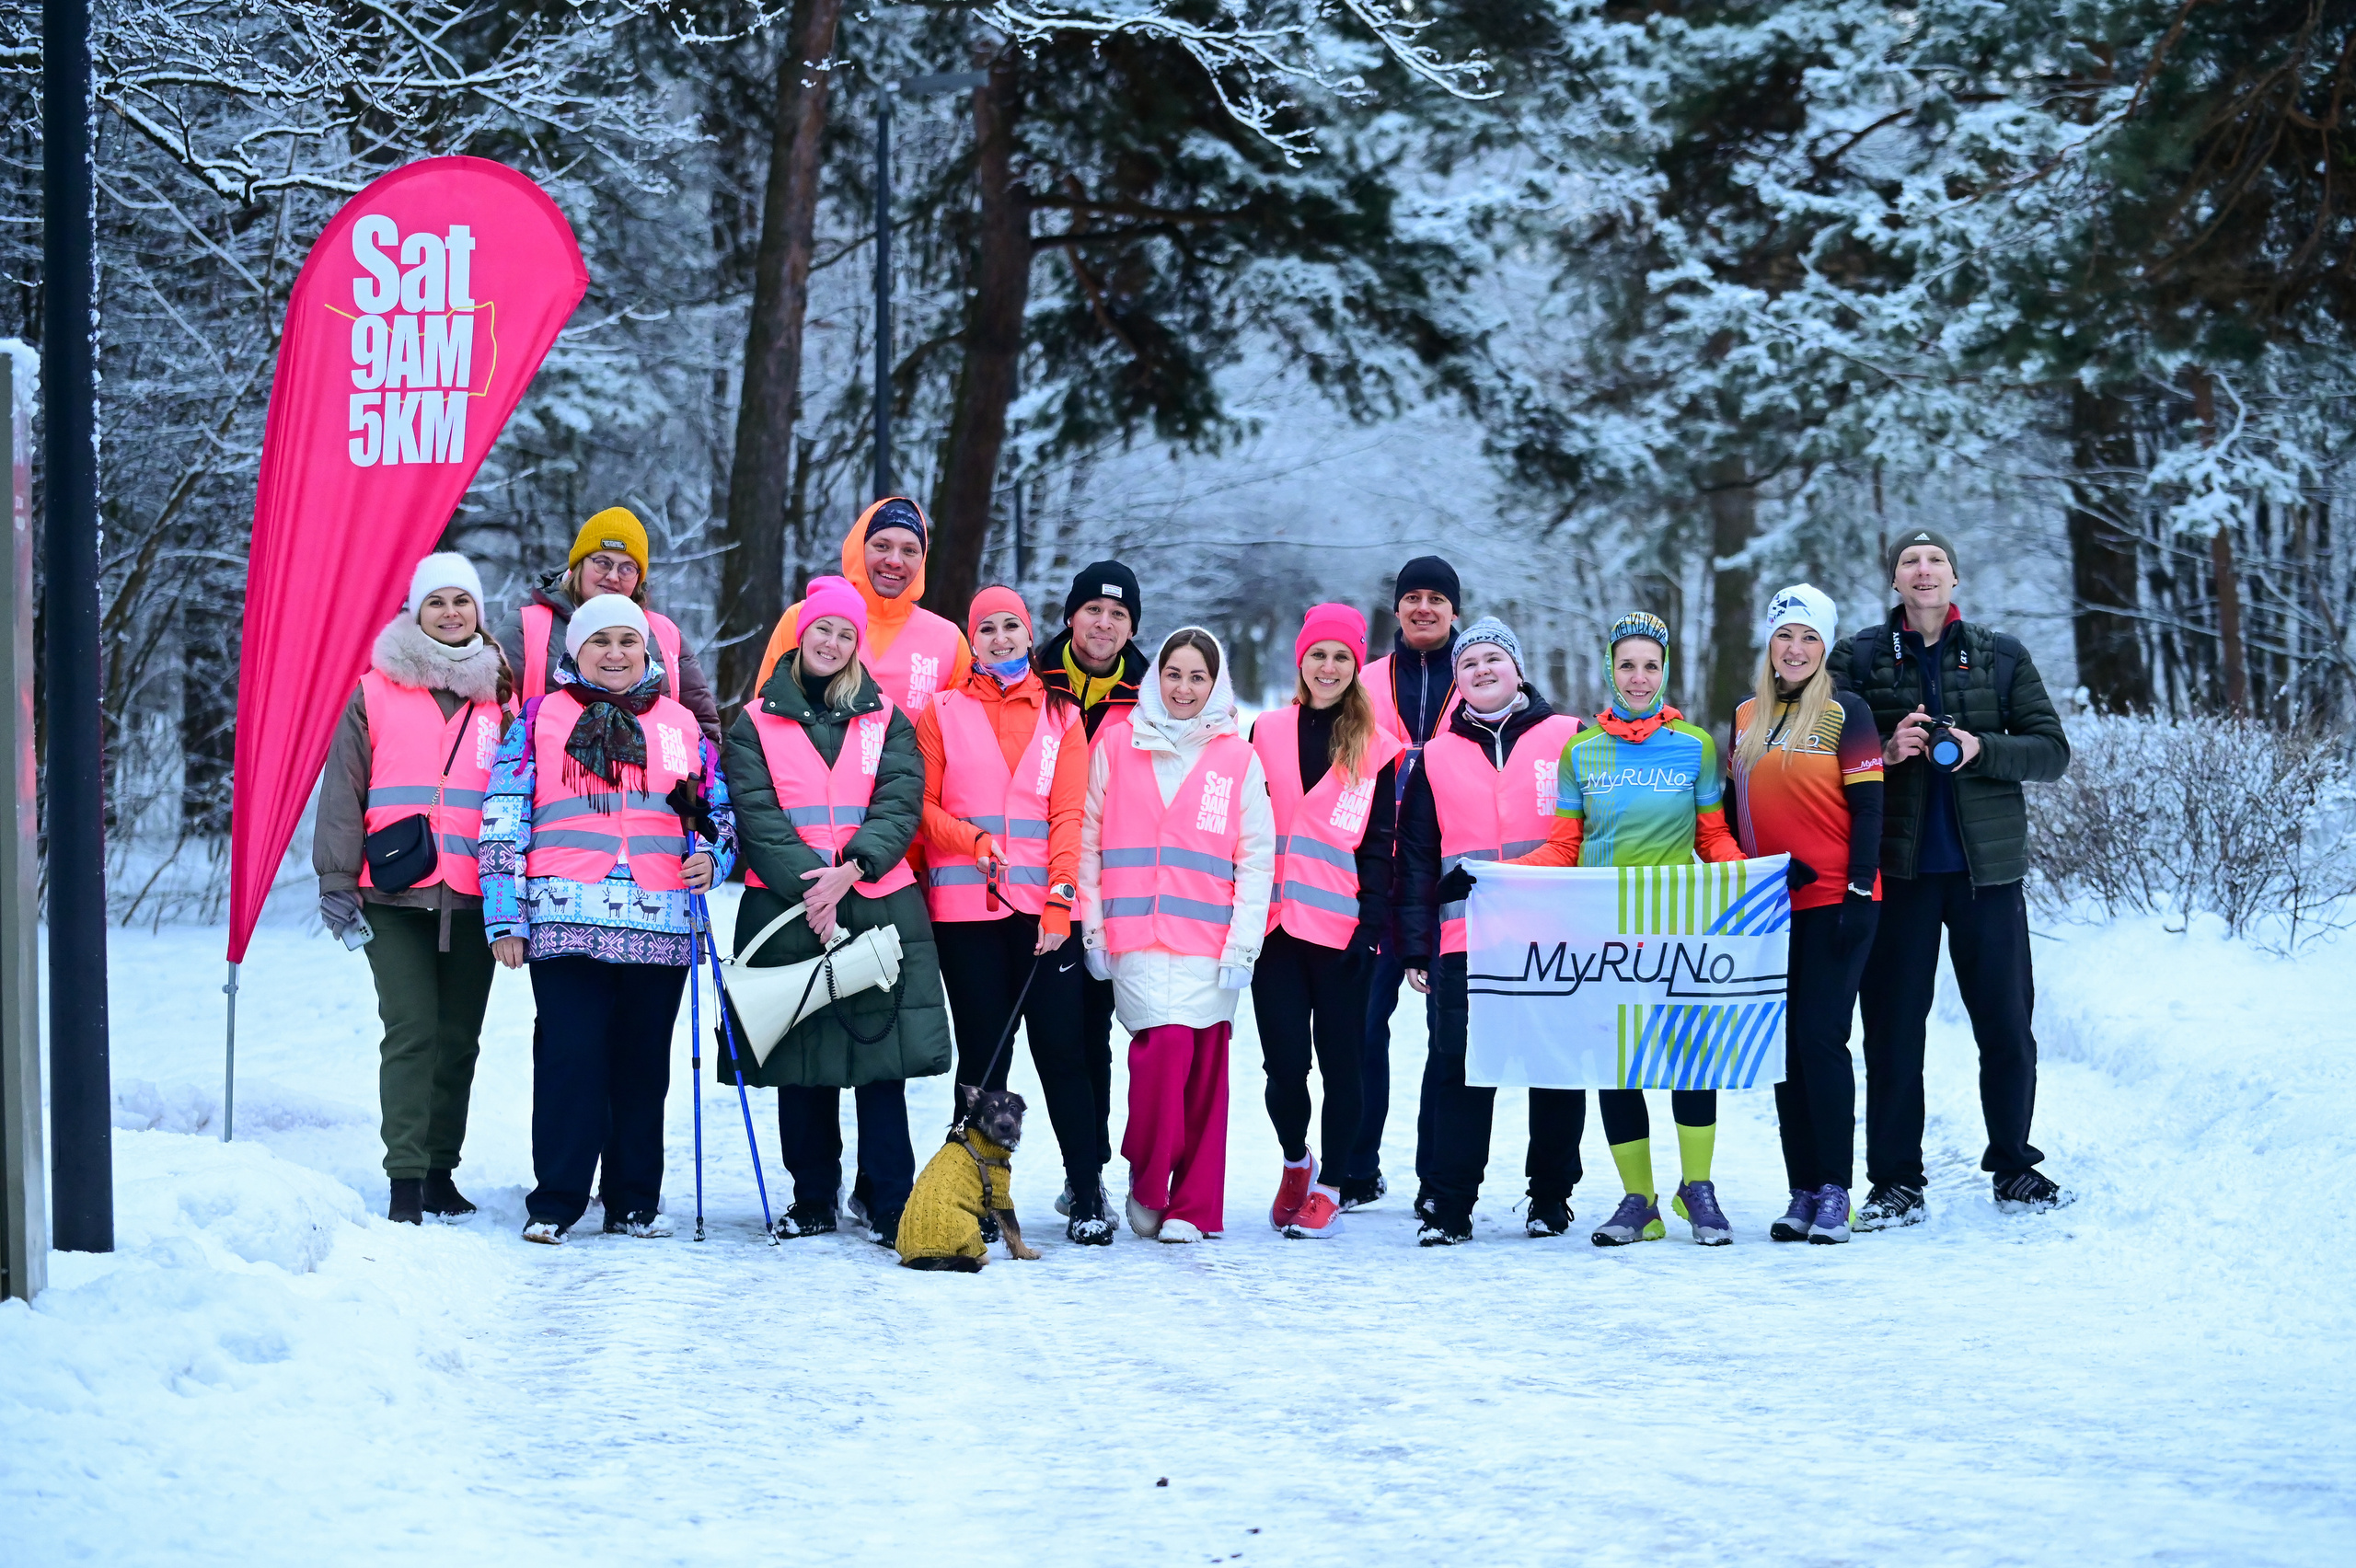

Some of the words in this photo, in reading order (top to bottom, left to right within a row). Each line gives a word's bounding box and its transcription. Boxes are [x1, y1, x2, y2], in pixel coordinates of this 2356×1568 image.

[352, 213, 476, 315] Sat
[351, 314, 475, 390] 9AM
[348, 390, 469, 467] 5KM
[1893, 632, 1902, 659] SONY
[910, 652, 939, 677] Sat
[909, 673, 938, 694] 9AM
[656, 722, 682, 745] Sat
[859, 718, 884, 744] Sat
[661, 739, 687, 761] 9AM
[1042, 734, 1061, 761] Sa
[476, 751, 495, 772] 5K
[663, 755, 688, 776] 5KM
[1039, 758, 1056, 779] 9A
[1533, 759, 1559, 780] Sa
[1203, 770, 1233, 800] Sat
[1587, 767, 1687, 794] MyRUNo
[1200, 793, 1230, 816] 9AM
[1336, 790, 1369, 817] 9AM
[1537, 798, 1556, 816] 5K
[1195, 811, 1227, 835] 5KM
[1329, 807, 1363, 834] 5KM
[1522, 941, 1735, 997] MyRUNo
